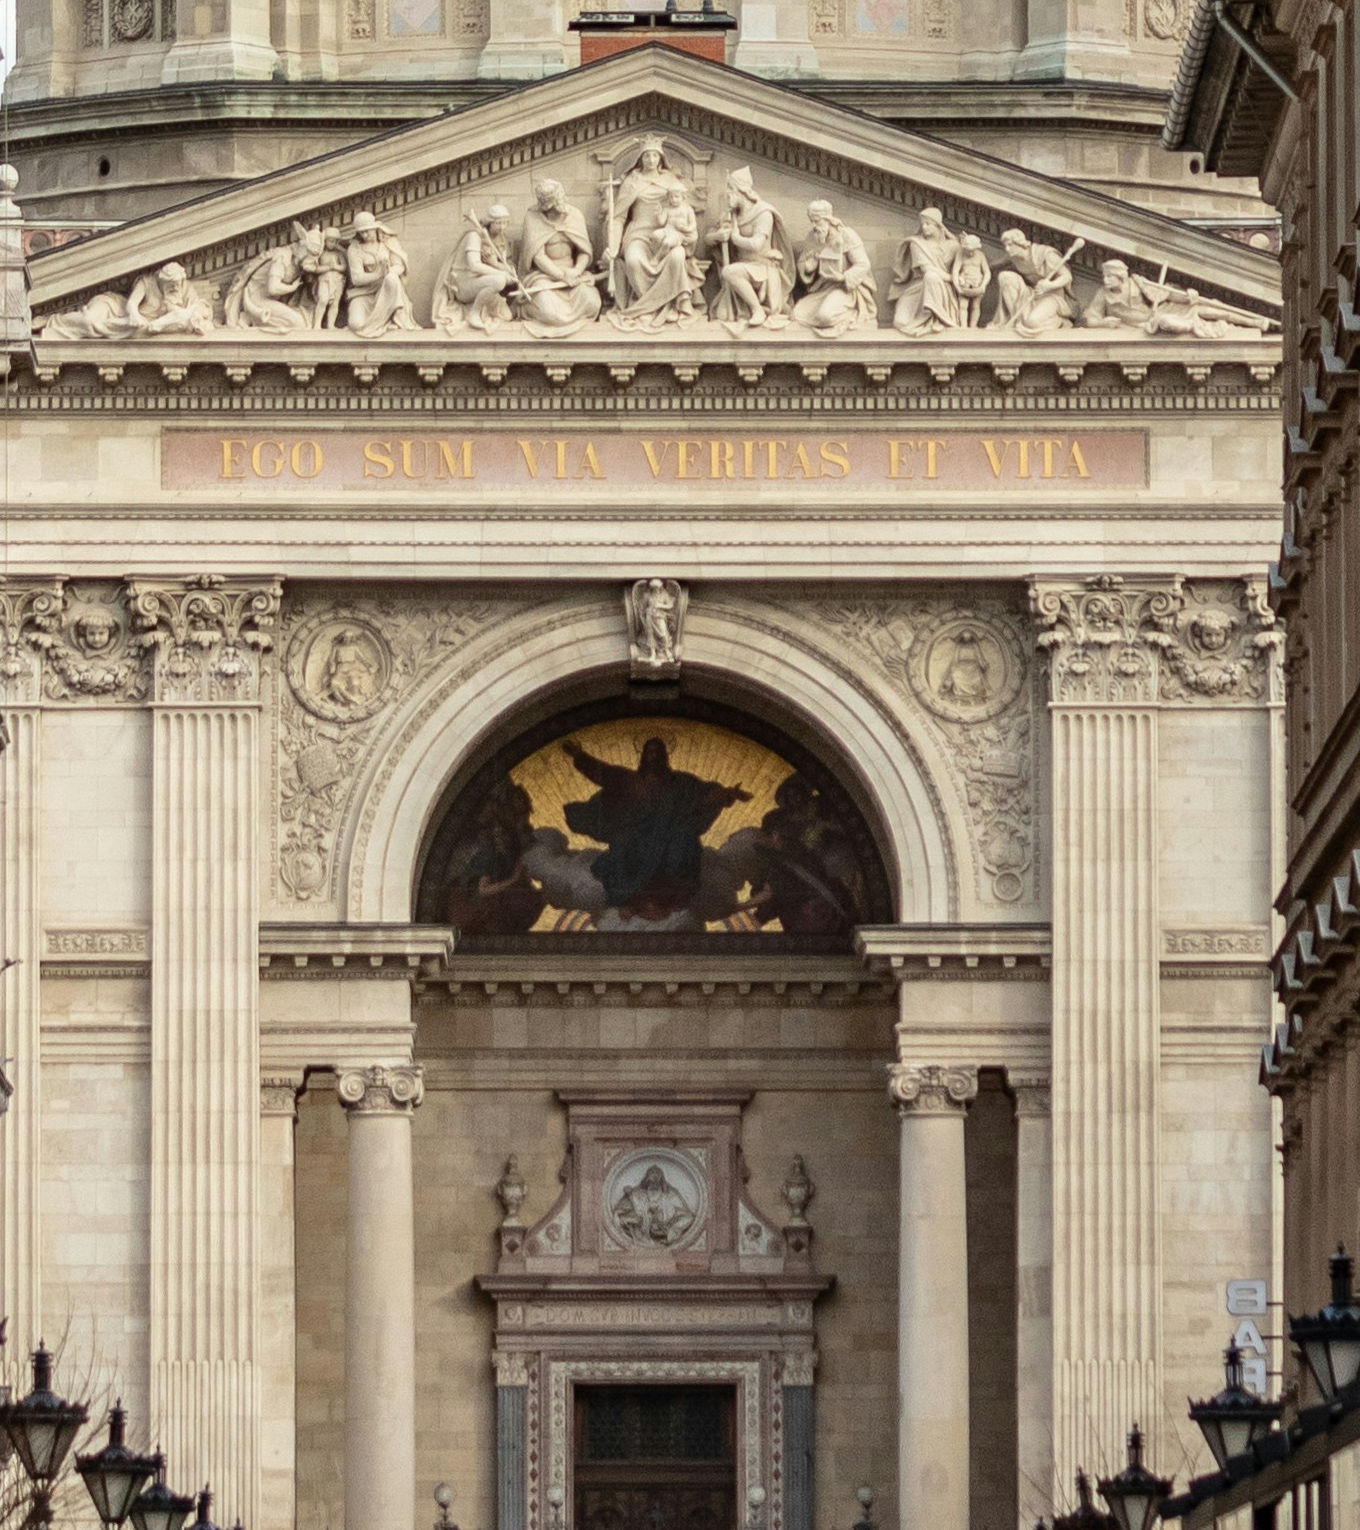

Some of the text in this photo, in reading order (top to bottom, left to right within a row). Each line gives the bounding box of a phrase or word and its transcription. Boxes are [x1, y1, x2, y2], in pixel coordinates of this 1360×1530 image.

[219, 440, 1092, 479] EGO SUM VIA VERITAS ET VITA
